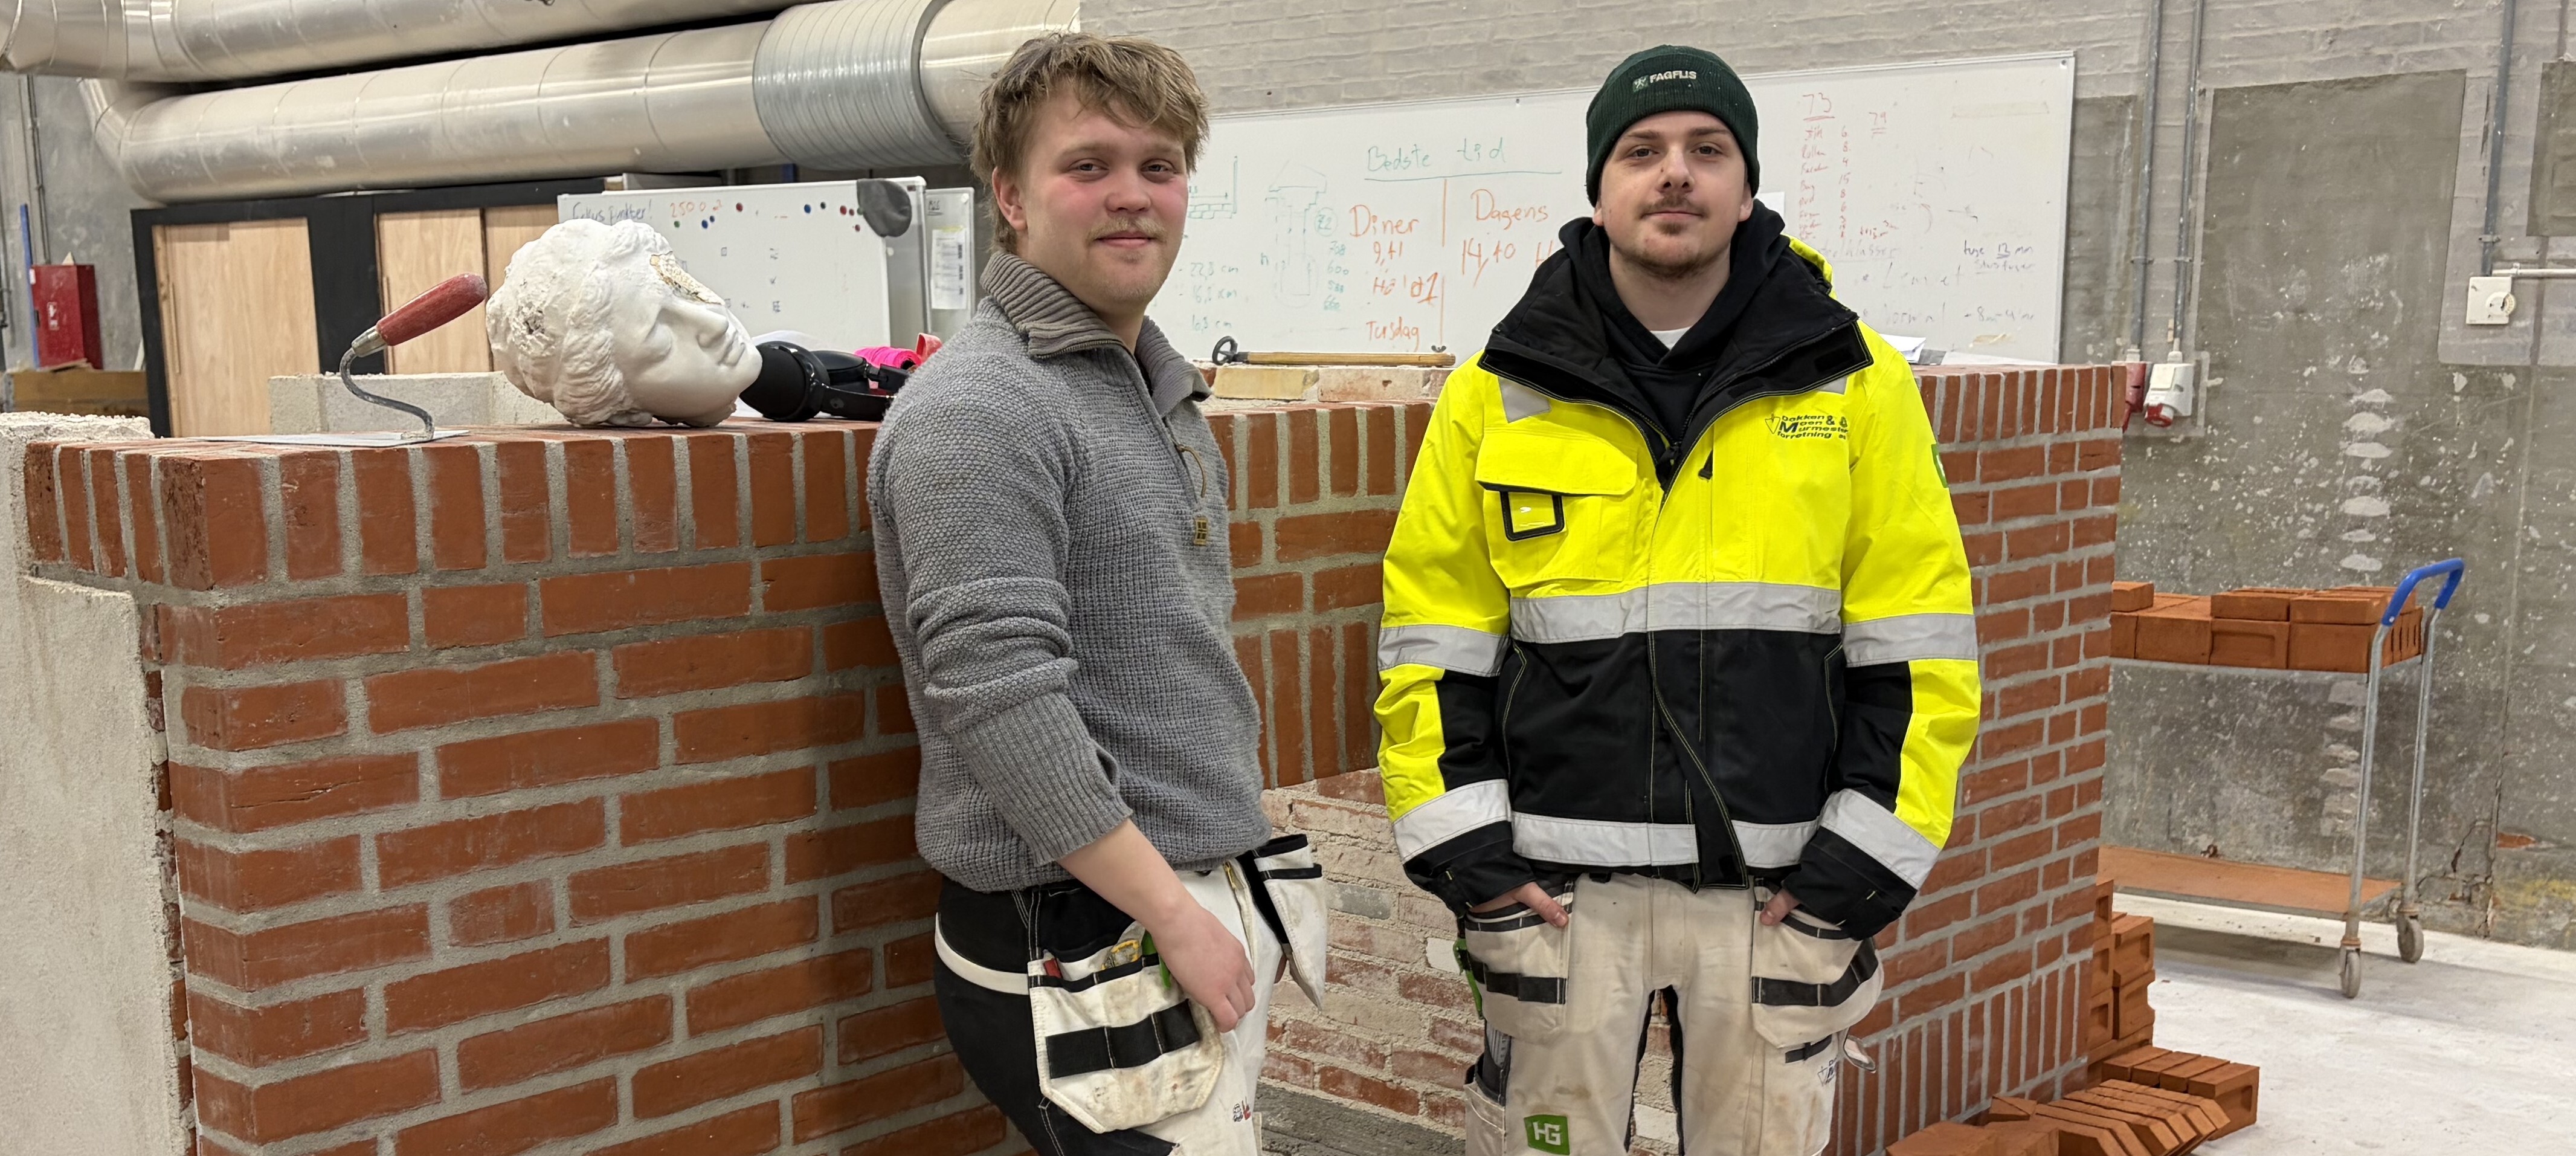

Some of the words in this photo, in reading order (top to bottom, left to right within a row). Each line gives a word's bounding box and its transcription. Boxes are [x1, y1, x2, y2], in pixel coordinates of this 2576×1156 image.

[1650, 70, 1697, 83] FAGFLIS
[1368, 144, 1431, 172] Bedste
[1457, 137, 1506, 163] tid
[1470, 189, 1548, 230] Dagens
[1533, 1122, 1562, 1146] HG
